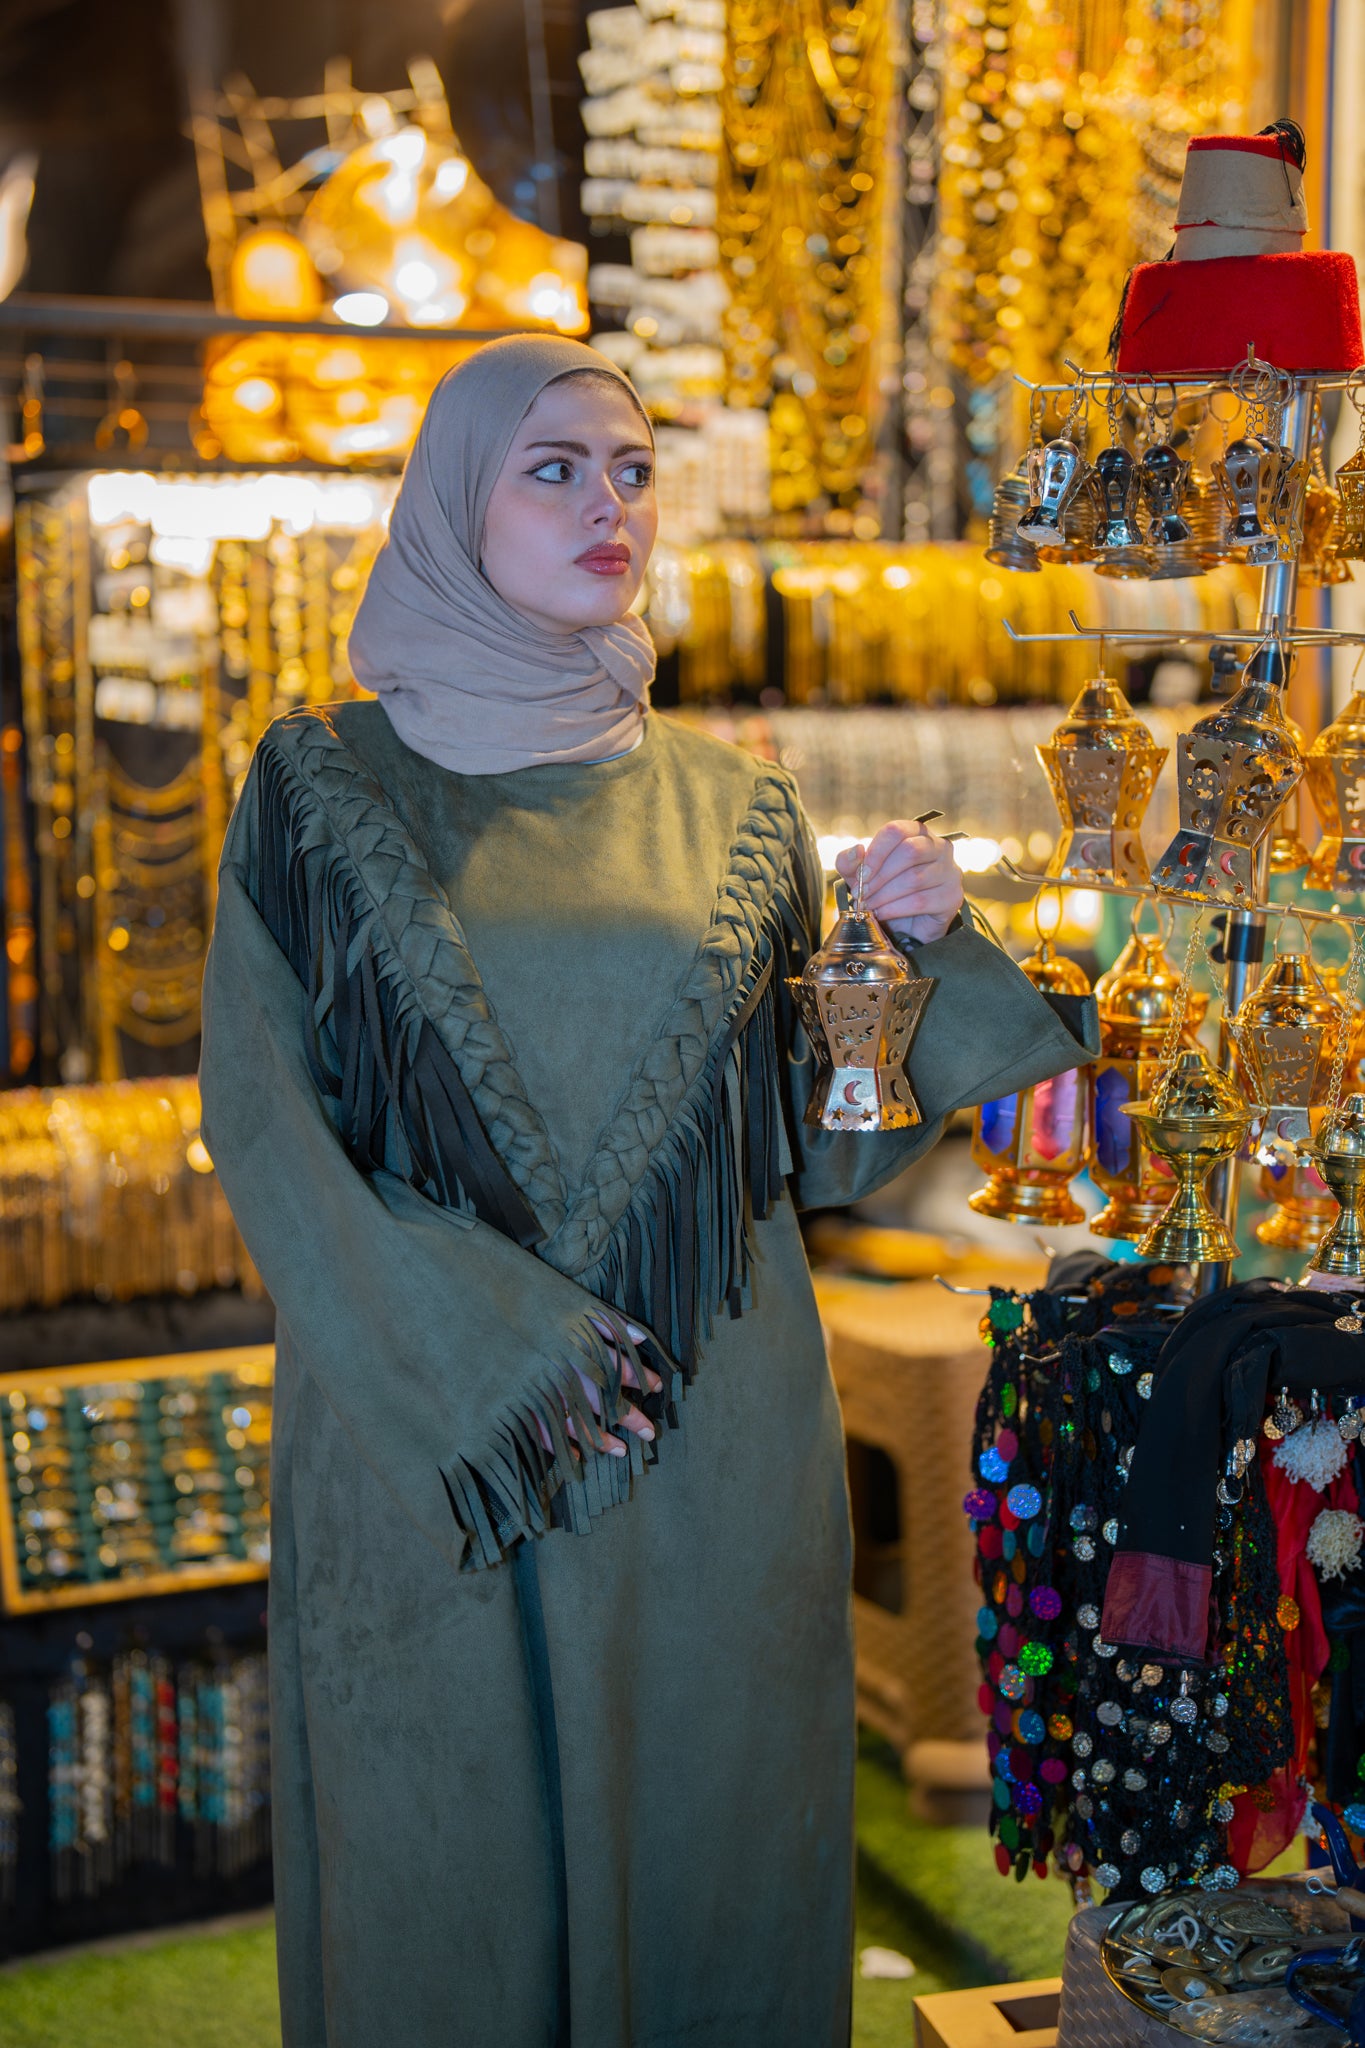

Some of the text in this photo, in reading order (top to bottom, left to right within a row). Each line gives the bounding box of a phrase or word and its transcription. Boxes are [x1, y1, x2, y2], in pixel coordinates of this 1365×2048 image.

[826, 1006, 881, 1026] رمضان
[834, 1025, 875, 1049] كريم
[1261, 1046, 1314, 1065] رمضان
[1268, 1065, 1309, 1090] كريم
